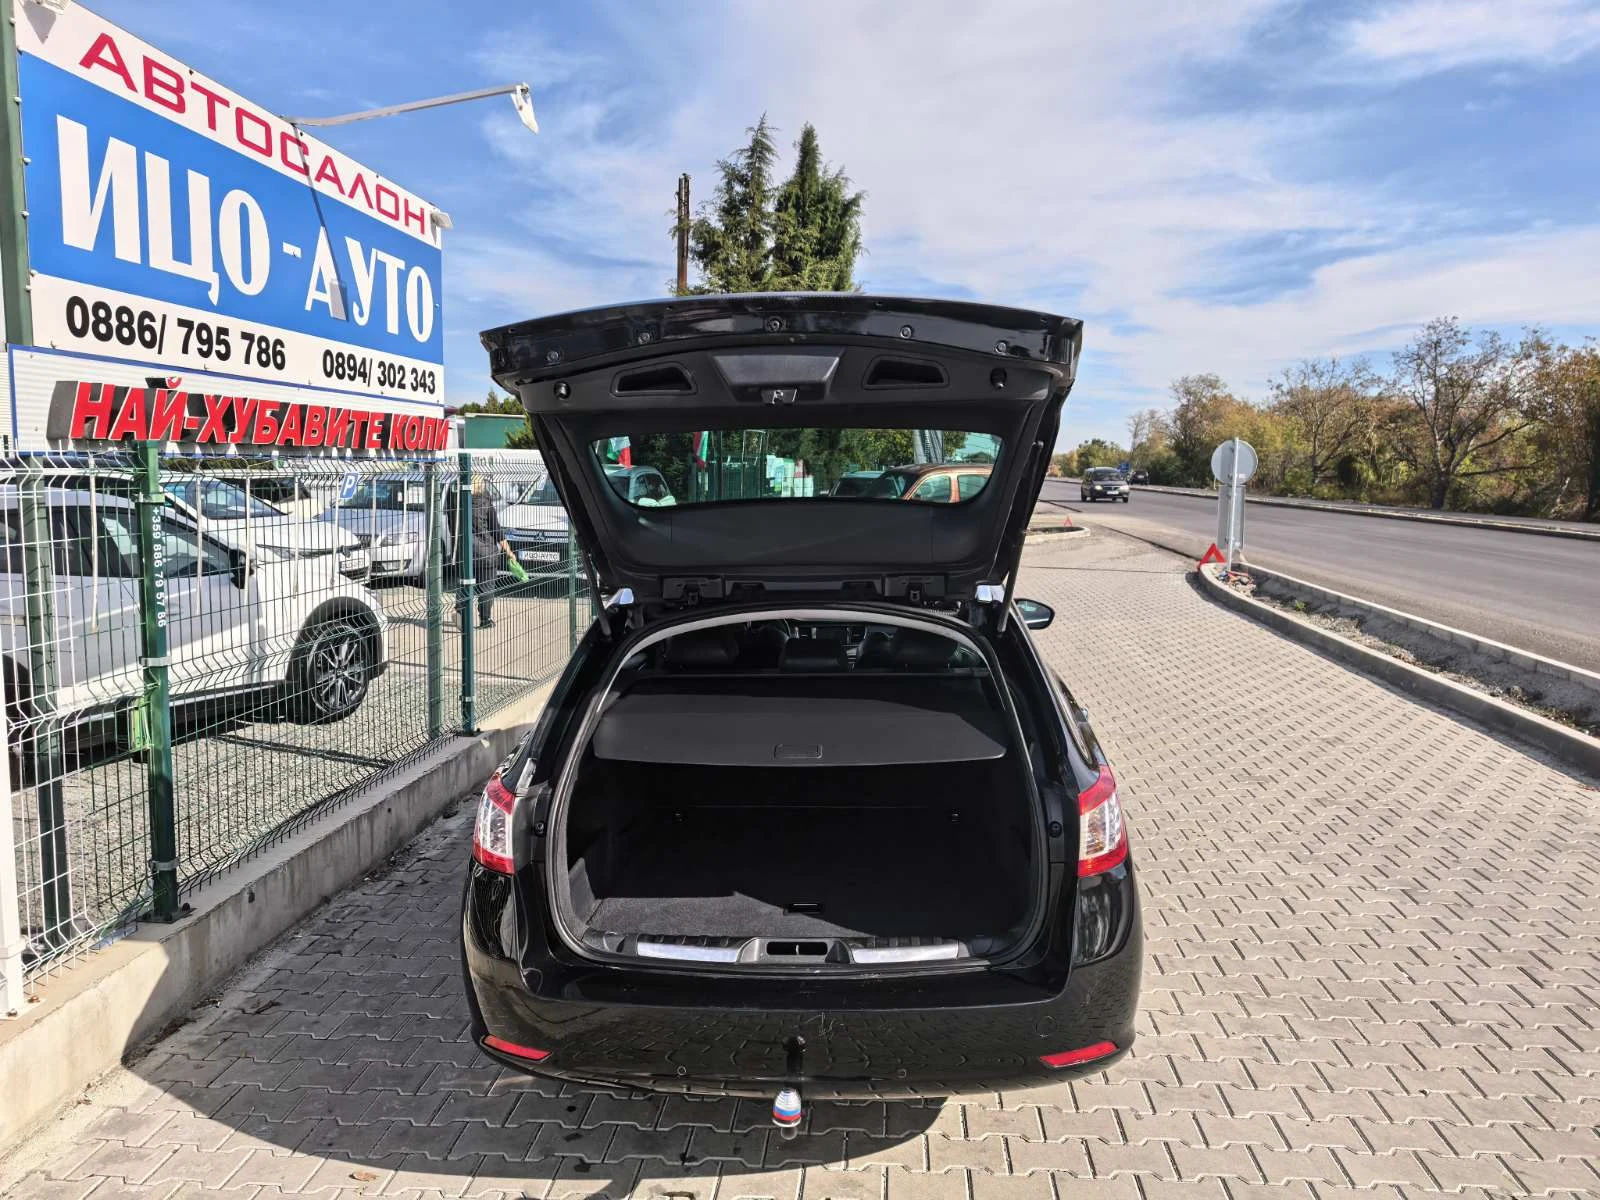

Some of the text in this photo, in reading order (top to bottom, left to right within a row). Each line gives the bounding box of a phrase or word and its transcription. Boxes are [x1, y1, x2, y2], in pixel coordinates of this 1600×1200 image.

[79, 32, 425, 235] АВТОСАЛОН
[65, 295, 286, 371] 0886/ 795 786
[322, 349, 436, 395] 0894/ 302 343
[70, 376, 449, 451] НАЙ-ХУБАВИТЕ КОЛИ
[152, 507, 167, 628] +359 886 79 57 86
